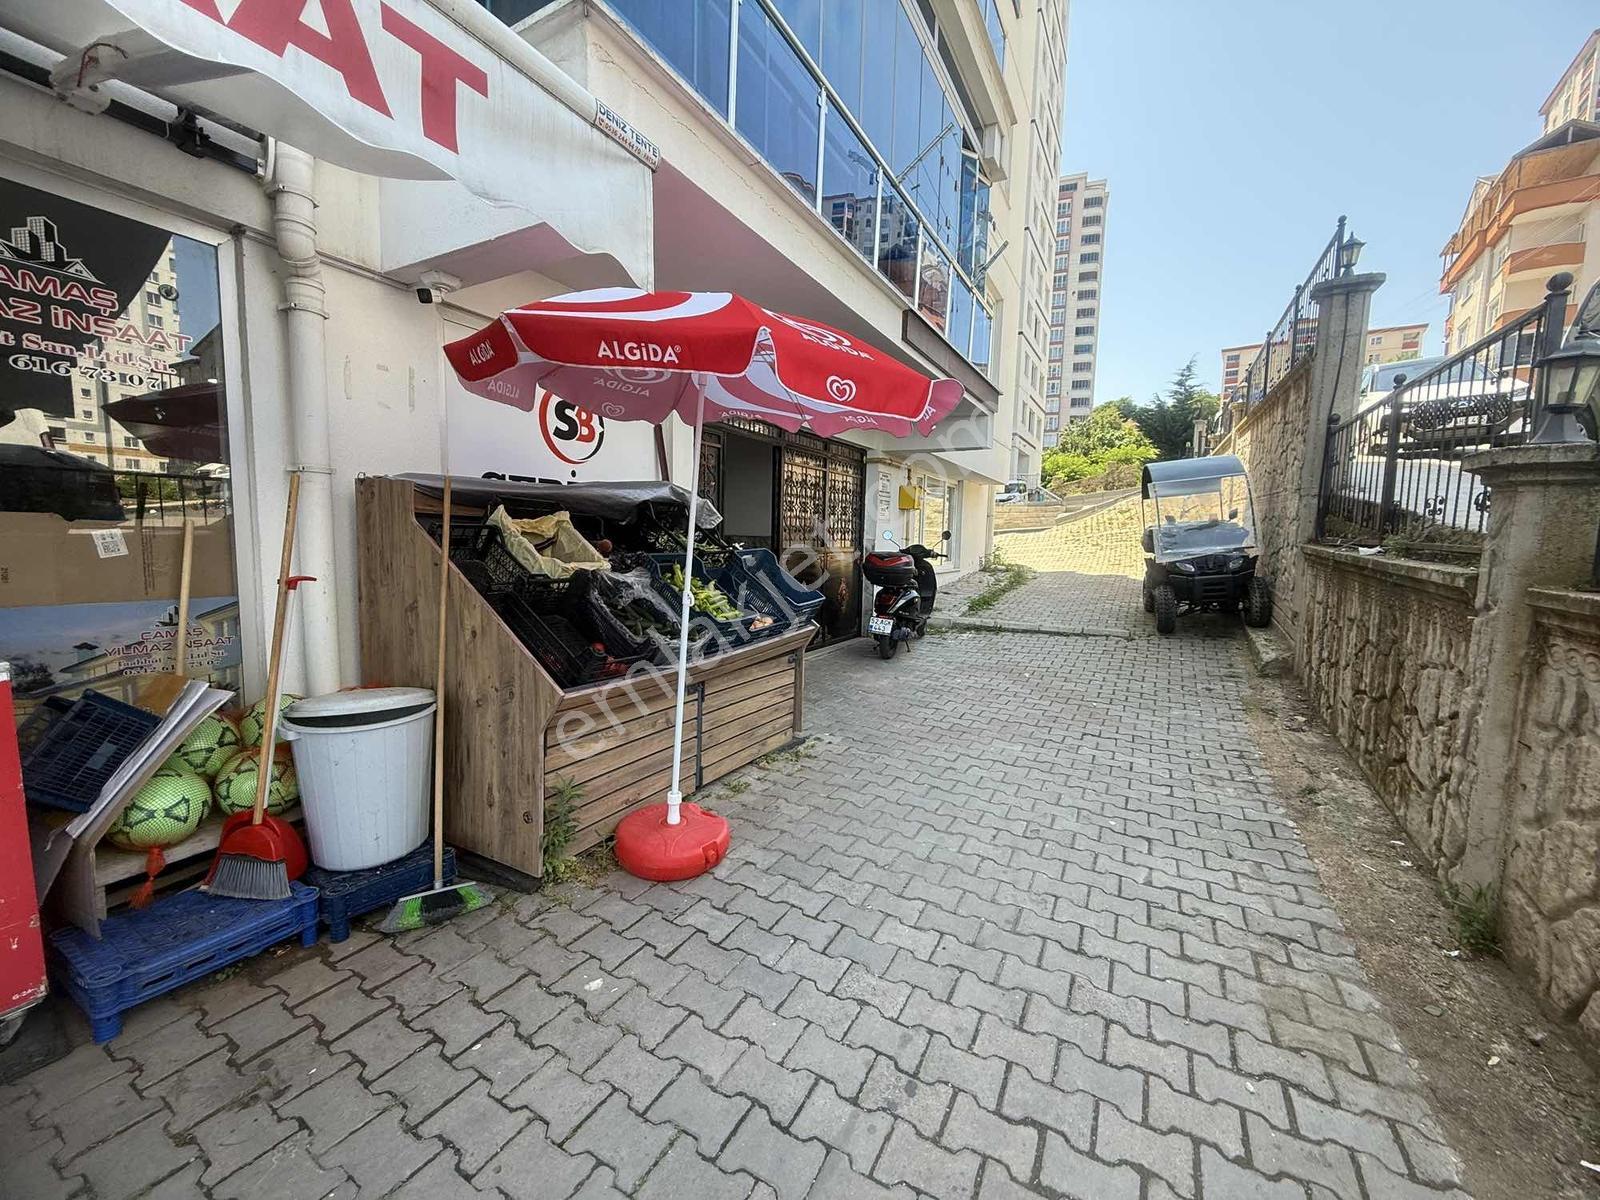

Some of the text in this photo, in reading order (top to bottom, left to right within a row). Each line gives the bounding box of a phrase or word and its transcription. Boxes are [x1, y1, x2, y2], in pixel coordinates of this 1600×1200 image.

[179, 0, 489, 155] AT
[629, 128, 658, 158] TENTE
[553, 400, 596, 443] SB
[104, 642, 173, 657] YILMAZ
